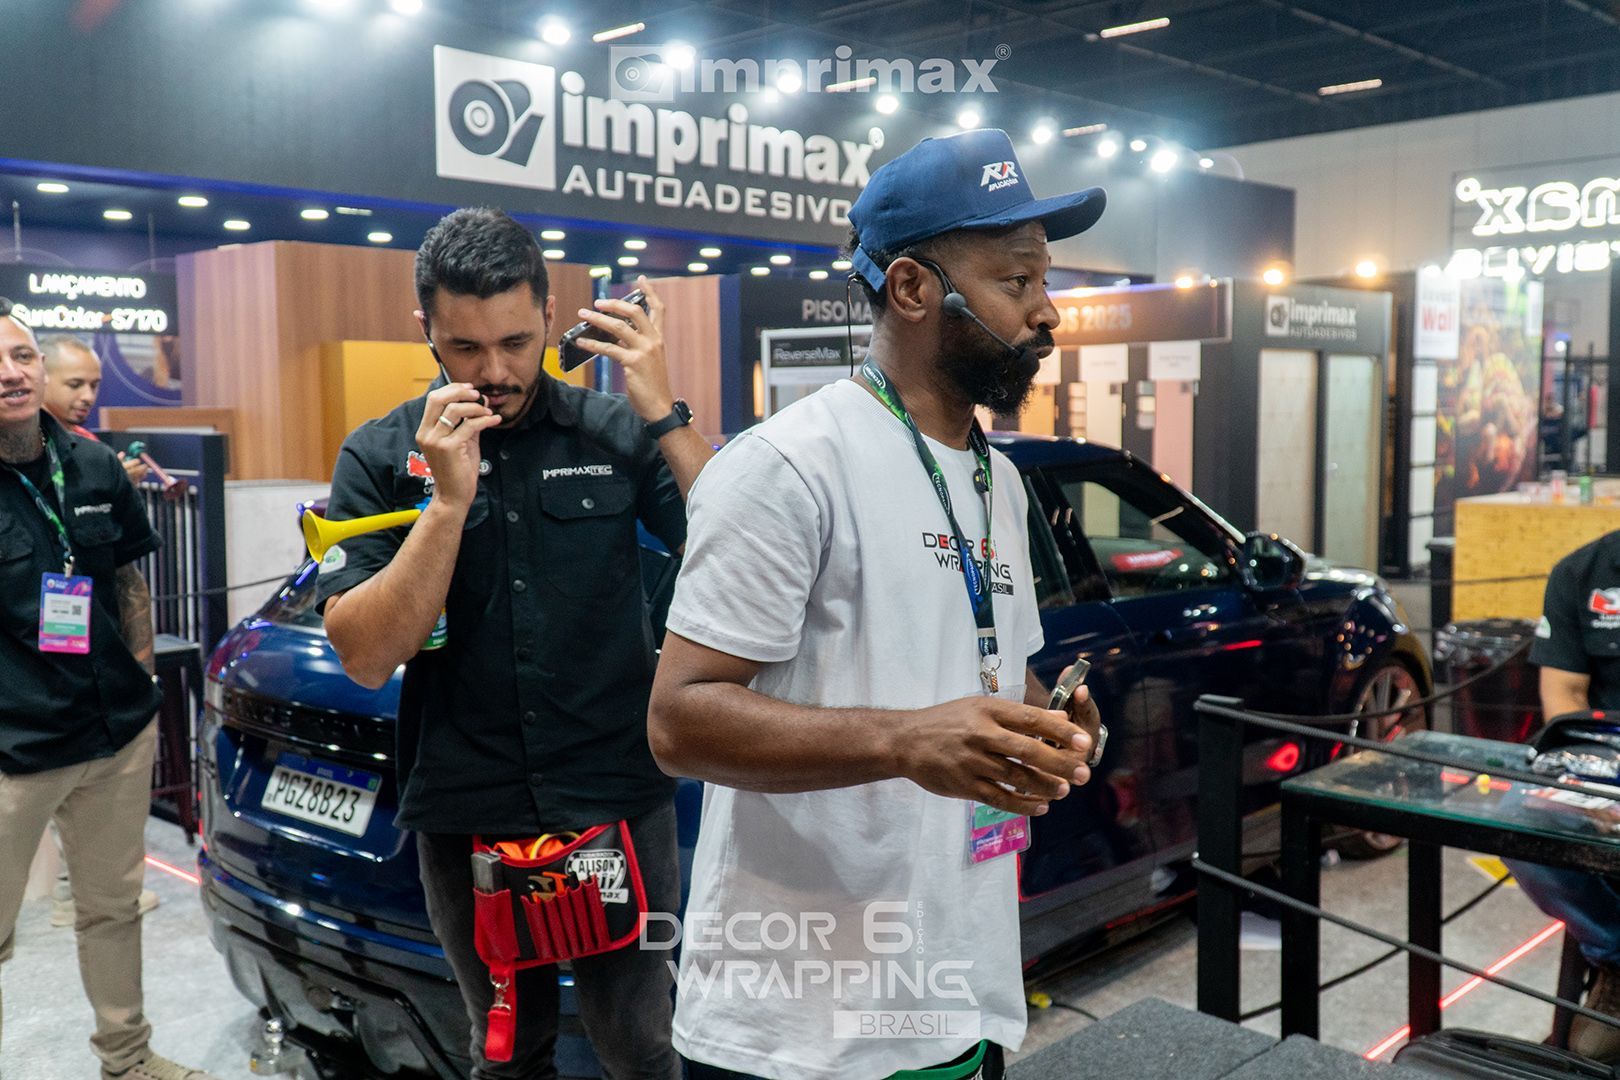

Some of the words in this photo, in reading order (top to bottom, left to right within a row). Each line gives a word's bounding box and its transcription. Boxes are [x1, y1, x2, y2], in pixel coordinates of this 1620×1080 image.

[562, 164, 853, 226] AUTOADESIVO
[28, 272, 147, 300] LANÇAMENTO
[11, 303, 104, 330] SureColor
[801, 298, 873, 322] PISOMA
[1080, 302, 1133, 332] 2025
[1290, 297, 1357, 327] imprimax
[578, 859, 615, 873] ALISON
